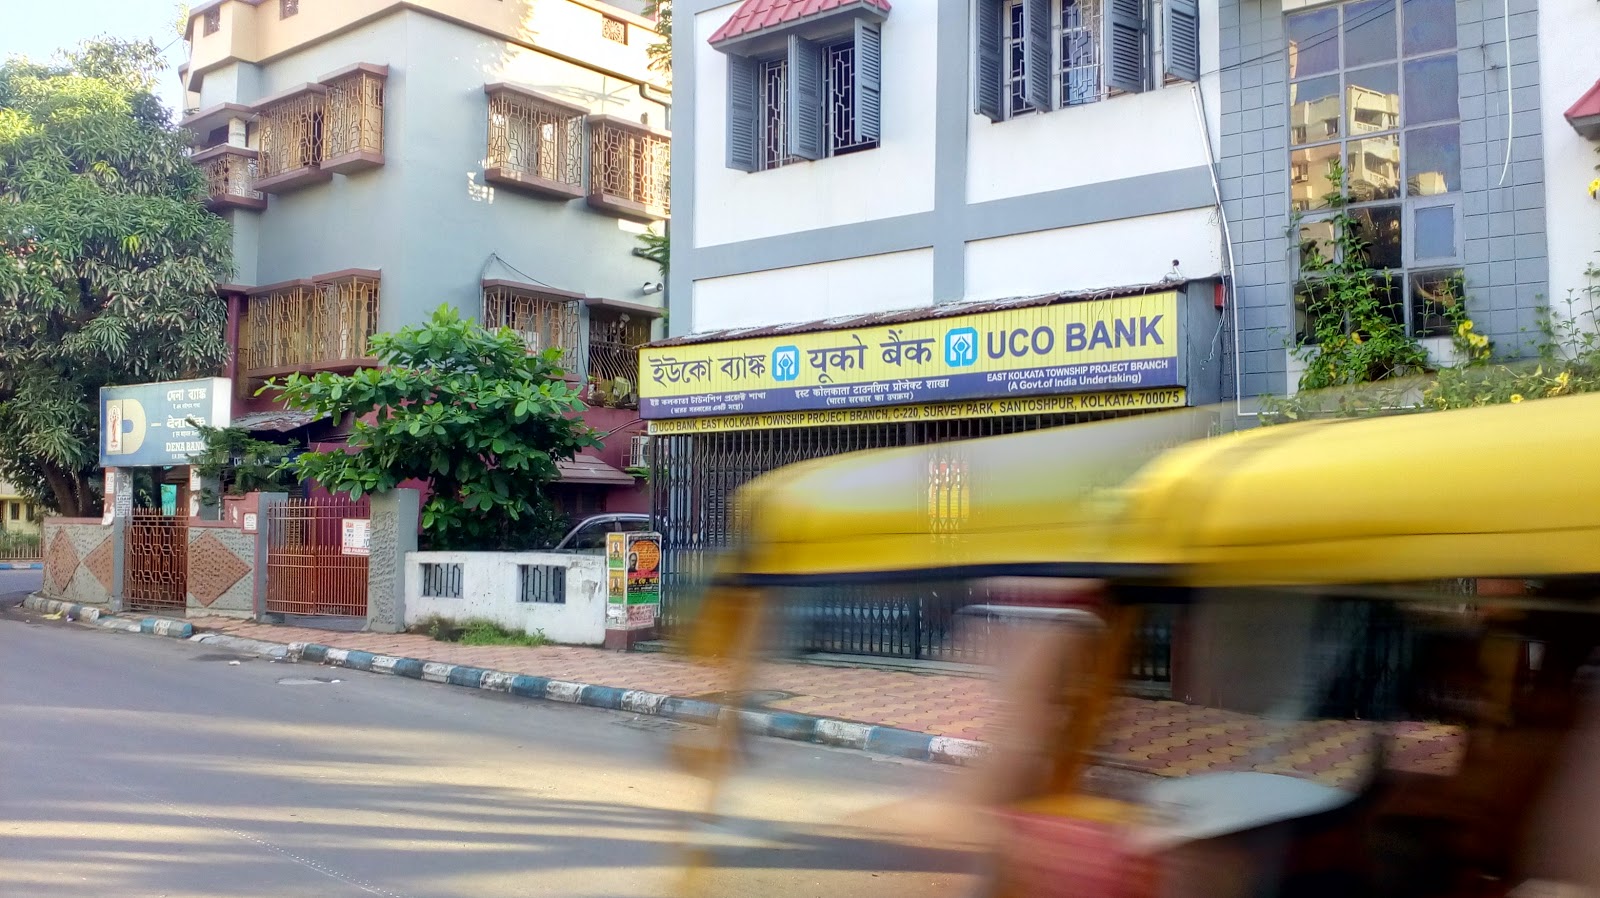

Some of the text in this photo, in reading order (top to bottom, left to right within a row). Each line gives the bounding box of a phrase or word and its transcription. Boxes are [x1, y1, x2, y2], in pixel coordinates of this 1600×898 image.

[986, 314, 1164, 360] UCO BANK
[807, 330, 936, 383] यूको बैंक
[648, 353, 766, 388] ইউকো ব্যাঙ্ক
[987, 360, 1168, 382] EAST KOLKATA TOWNSHIP PROJECT BRANCH
[813, 386, 850, 397] कोलकाता
[853, 382, 890, 394] टाउनशिप
[892, 379, 922, 391] प्रोजेक्ट
[926, 379, 949, 389] शाखा
[1008, 381, 1018, 392] (A
[1054, 375, 1077, 386] India
[1079, 372, 1141, 385] Undertaking)
[167, 388, 184, 401] দেনা
[661, 396, 689, 406] কলকাতা
[690, 394, 722, 405] টাউনশিপ
[749, 392, 766, 400] শাখা
[826, 396, 846, 406] (भारत
[849, 395, 871, 404] सरकार
[874, 394, 884, 402] का
[659, 390, 1179, 432] UCO BANK, EAST KOLKATA TOWNSHIP PROJECT BRANCH, C-220, SURVEY PARK, SANTOSHPUR, KOLKATA-700075
[166, 442, 185, 452] DENA
